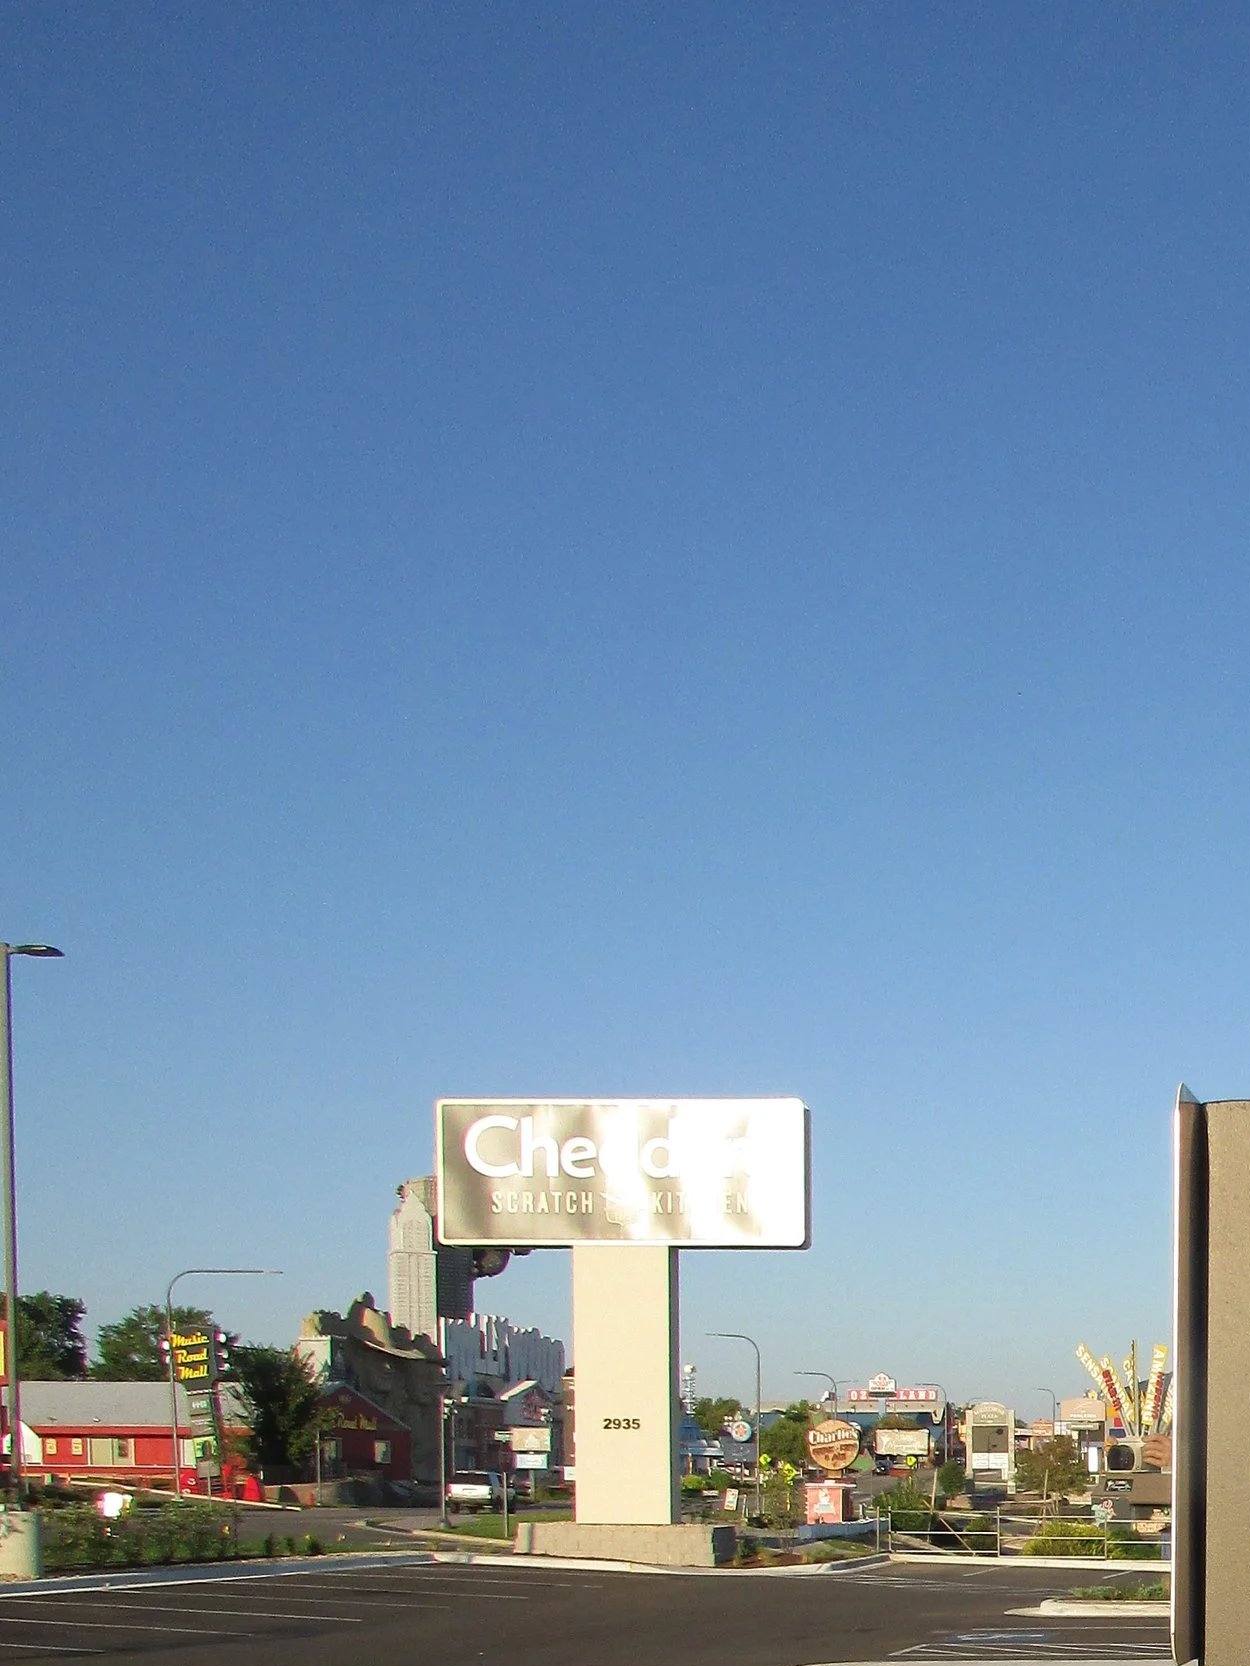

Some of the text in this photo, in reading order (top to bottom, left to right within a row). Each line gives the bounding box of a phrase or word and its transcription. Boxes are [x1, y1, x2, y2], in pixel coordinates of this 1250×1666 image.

[491, 1191, 749, 1214] SCRATCH KITEN
[170, 1332, 209, 1347] Music
[174, 1348, 209, 1363] Road
[177, 1364, 209, 1379] Mall
[850, 1390, 937, 1400] OZLAND
[603, 1418, 641, 1430] 2935
